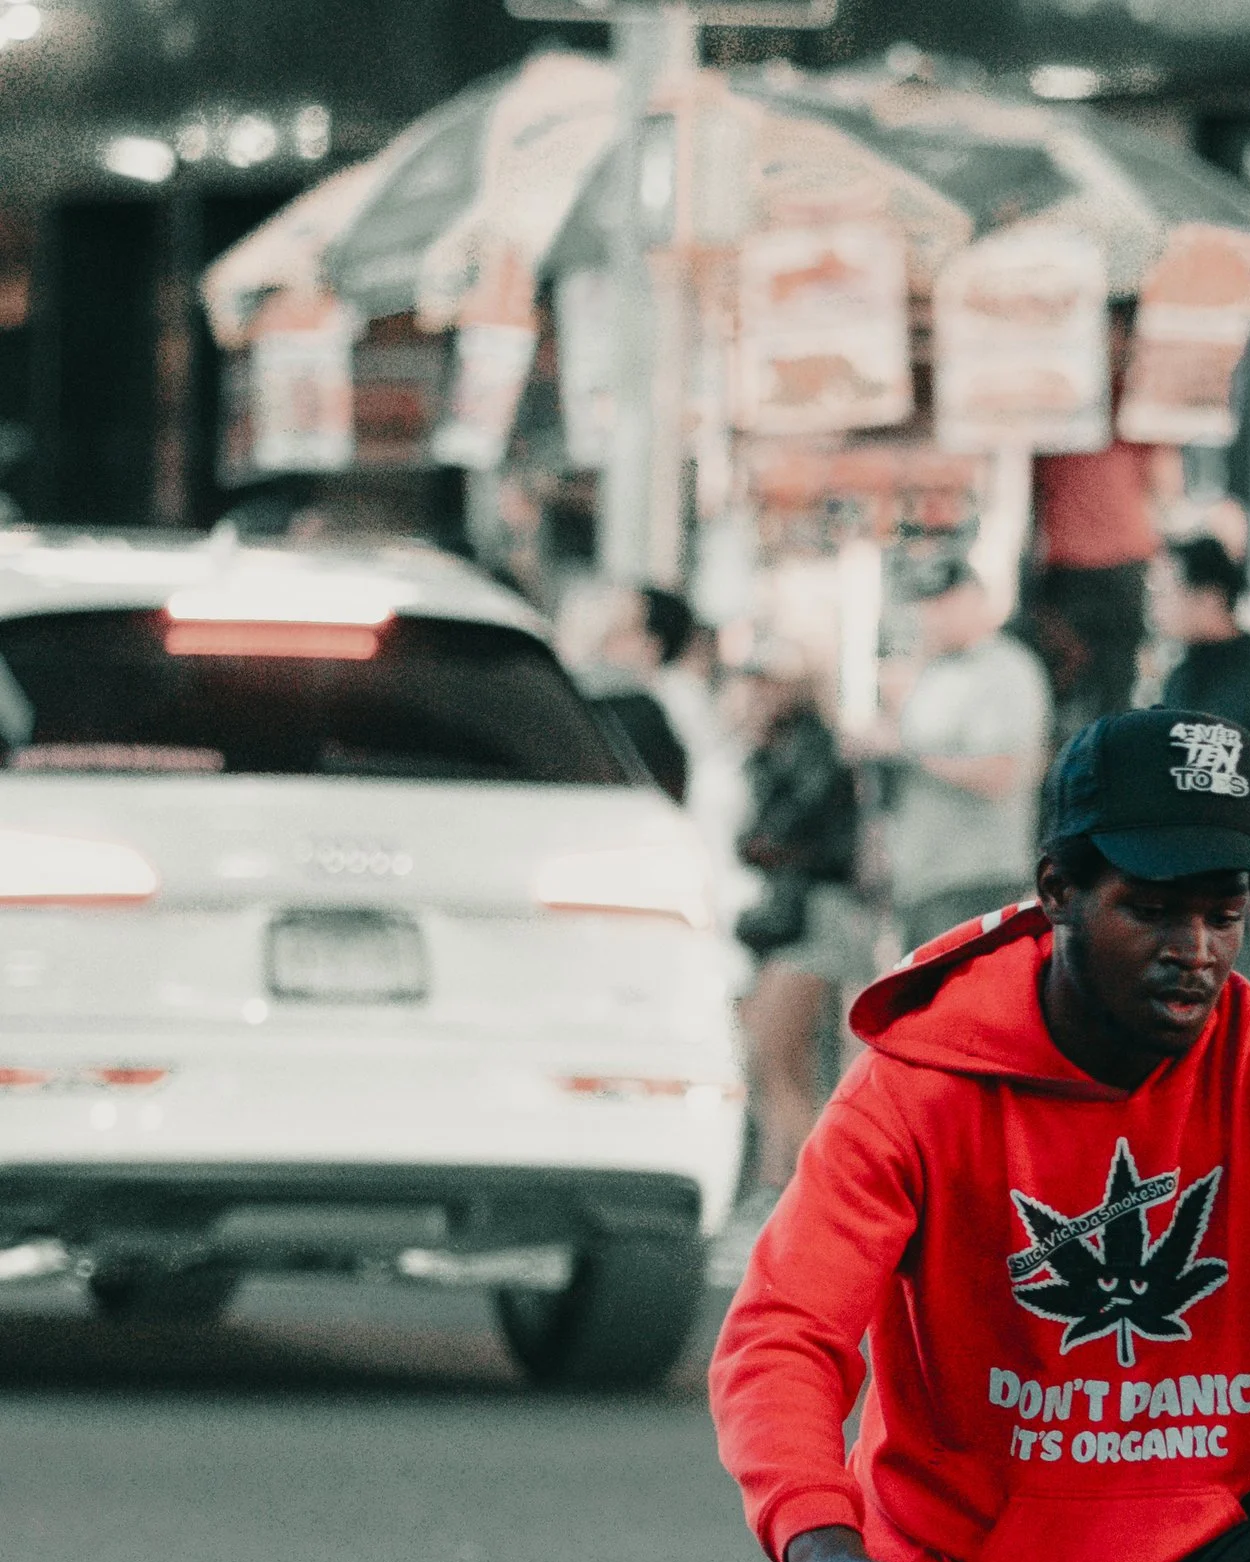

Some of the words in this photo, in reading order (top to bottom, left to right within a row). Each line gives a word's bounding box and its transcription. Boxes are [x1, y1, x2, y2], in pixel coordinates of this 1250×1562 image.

[989, 1367, 1110, 1422] DON'T
[1010, 1425, 1063, 1461] IT'S
[1071, 1425, 1228, 1463] ORGANIC
